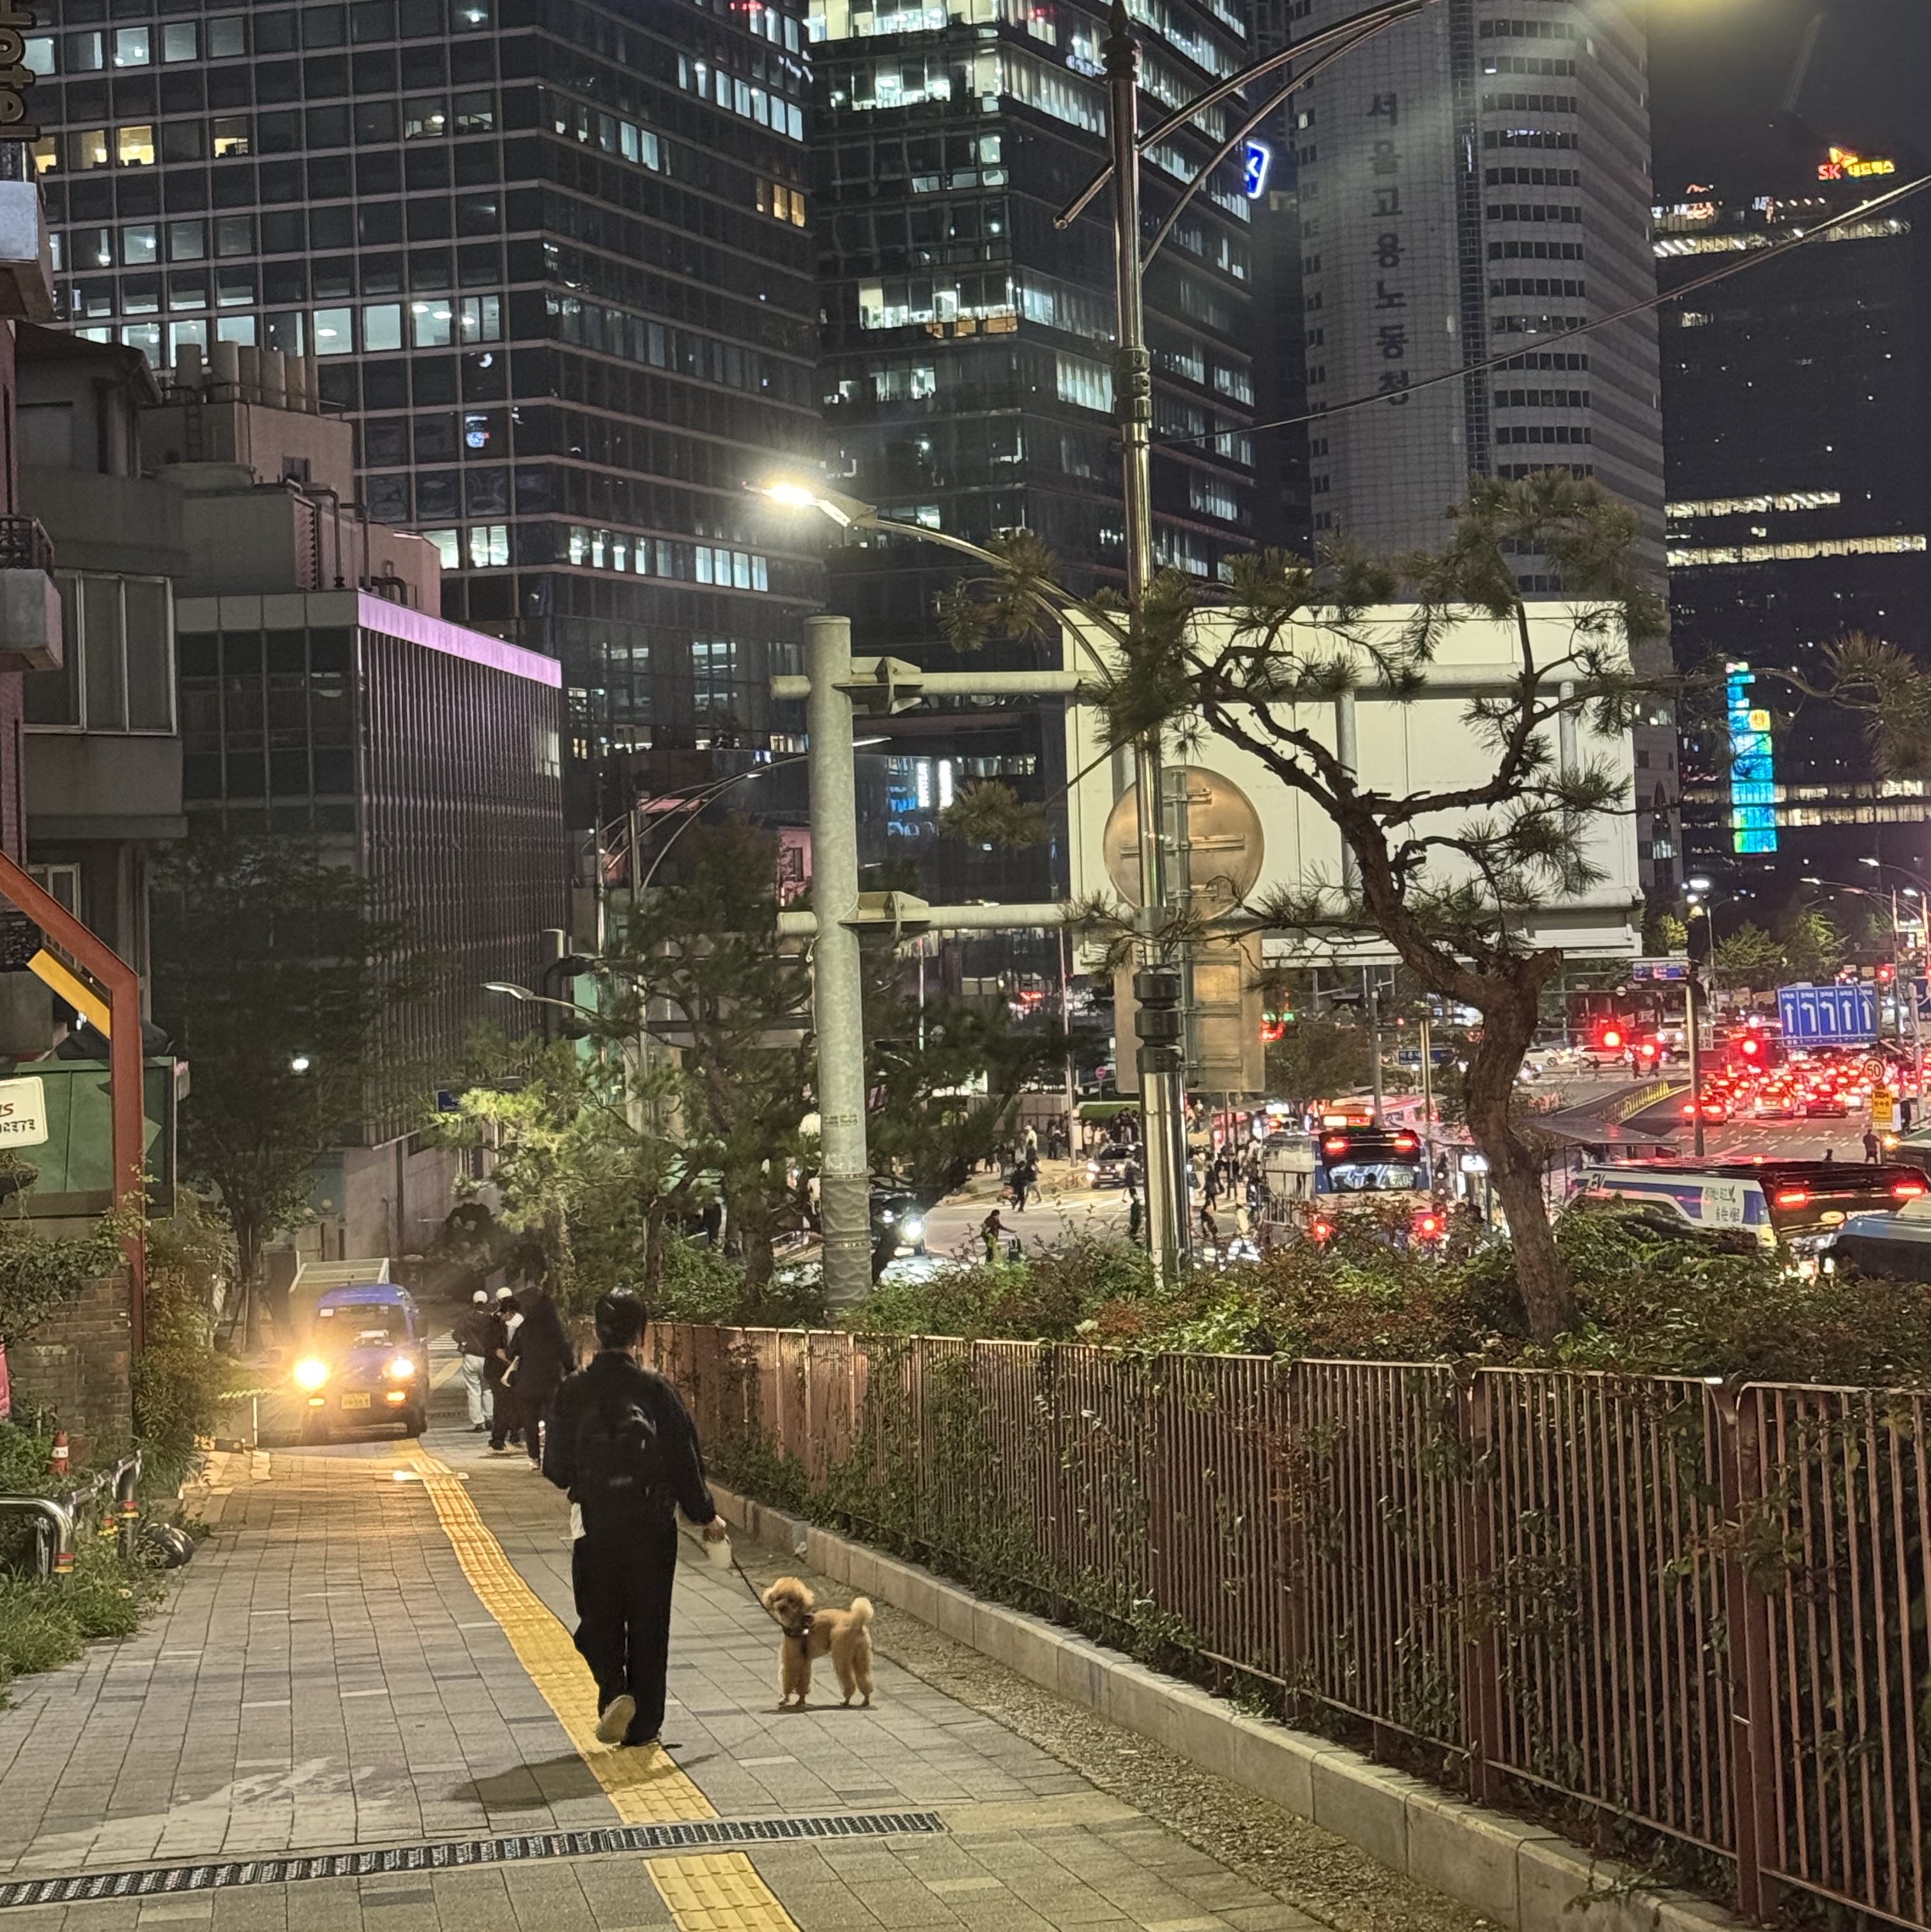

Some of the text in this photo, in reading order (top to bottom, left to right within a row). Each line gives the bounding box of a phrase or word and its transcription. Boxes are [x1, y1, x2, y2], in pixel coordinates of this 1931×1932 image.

[1818, 164, 1841, 180] SK
[1368, 93, 1409, 406] 서울고용노동청
[1866, 1064, 1881, 1077] 50
